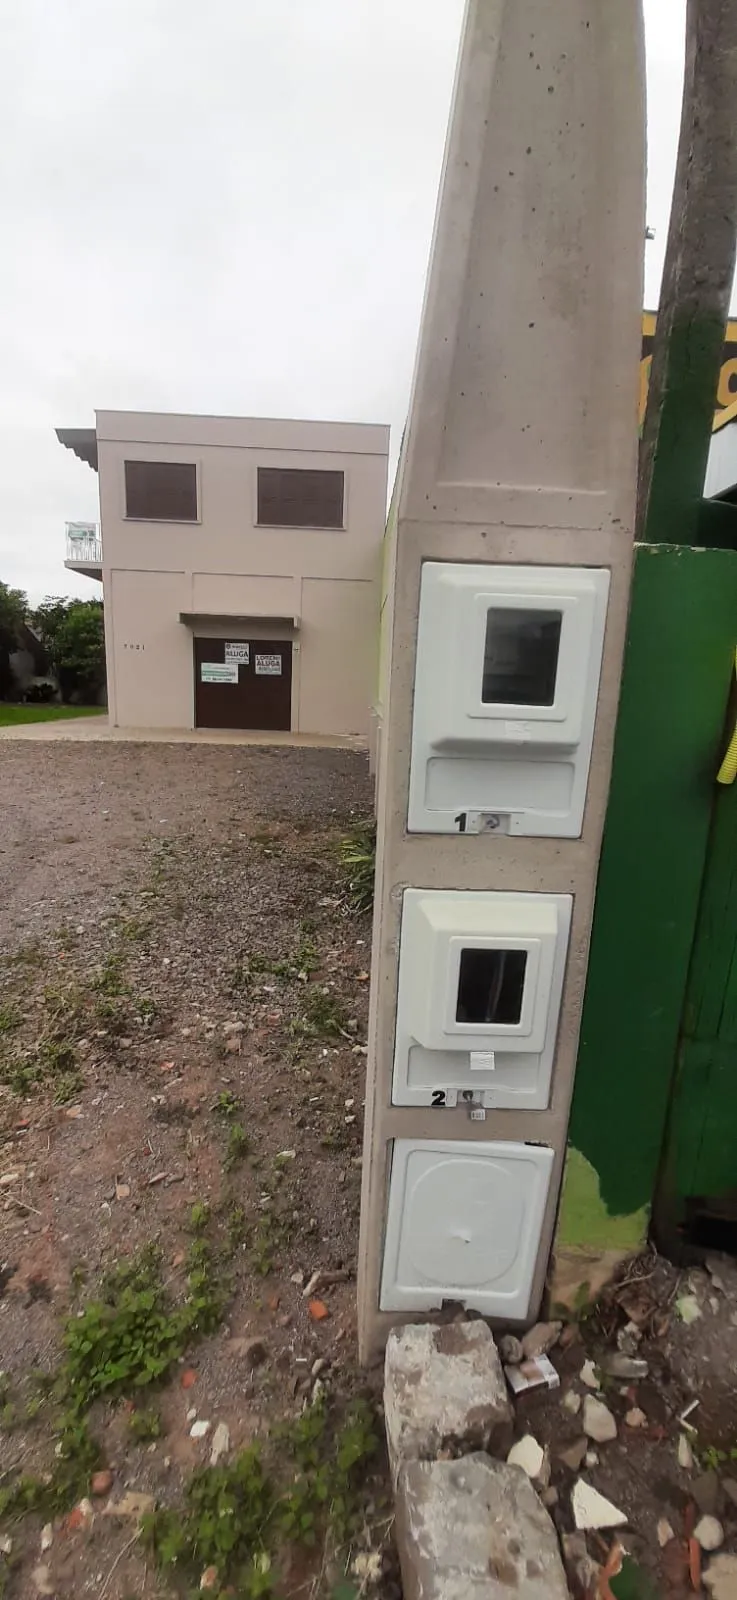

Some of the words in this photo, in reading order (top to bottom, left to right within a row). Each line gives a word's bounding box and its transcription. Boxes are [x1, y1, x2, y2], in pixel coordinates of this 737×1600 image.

[225, 649, 249, 658] ALUGA
[454, 812, 467, 832] 1
[431, 1090, 446, 1106] 2
